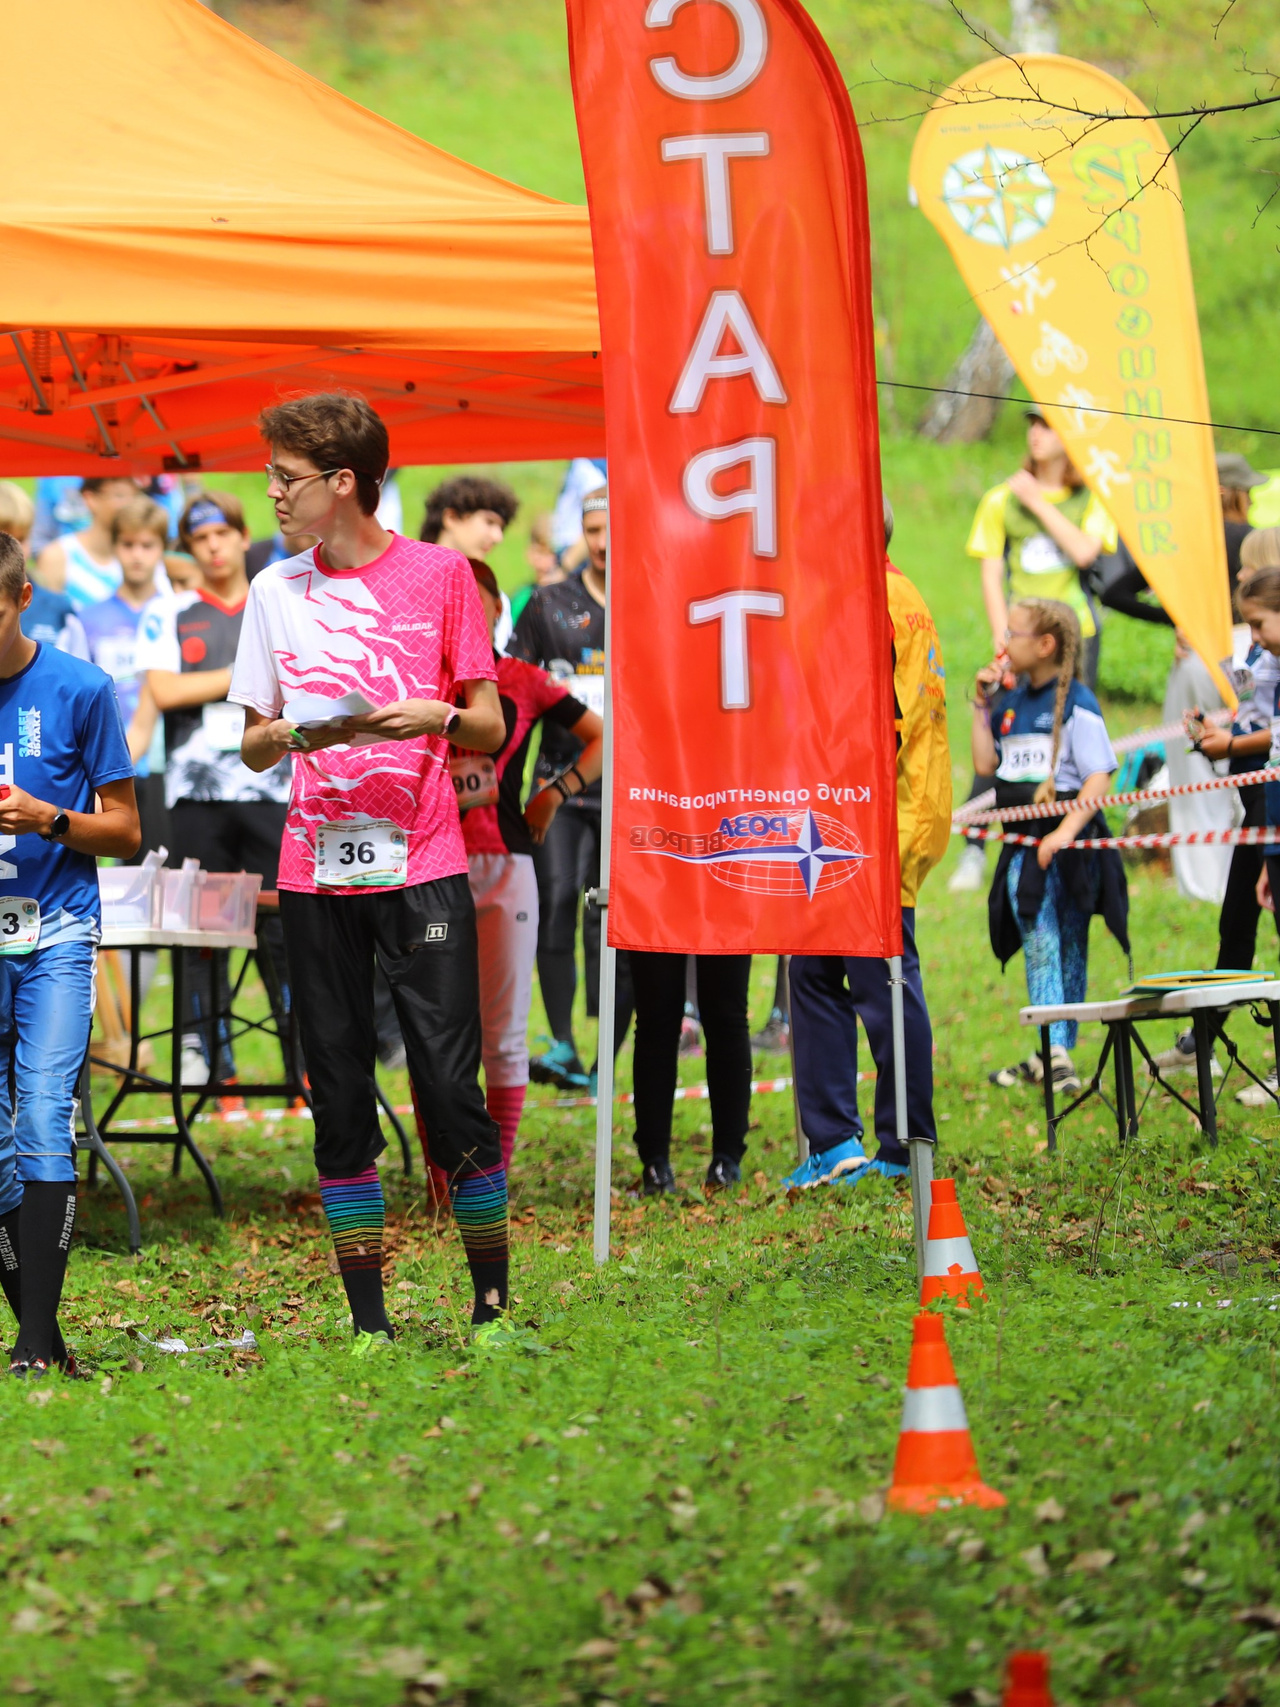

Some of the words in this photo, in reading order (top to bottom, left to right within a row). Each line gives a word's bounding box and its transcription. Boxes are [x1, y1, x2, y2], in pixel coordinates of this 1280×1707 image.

[18, 706, 30, 758] ЗАБЕГ
[33, 710, 41, 758] ОБЛАКА
[339, 841, 376, 865] 36
